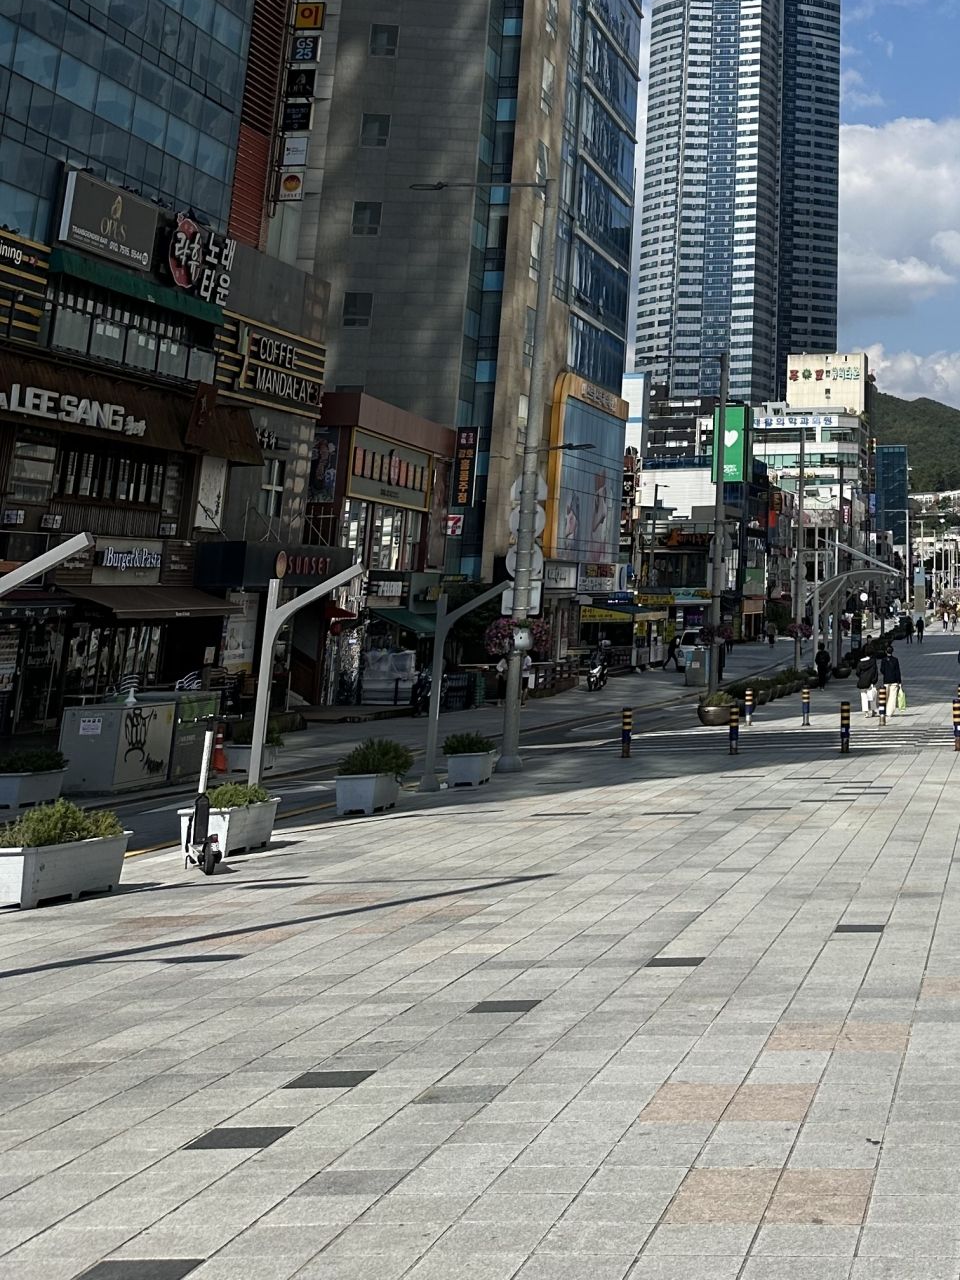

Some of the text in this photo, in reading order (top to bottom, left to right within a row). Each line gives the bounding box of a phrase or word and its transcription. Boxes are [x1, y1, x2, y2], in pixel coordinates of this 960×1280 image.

[295, 48, 312, 60] 25
[297, 38, 314, 49] GS
[205, 232, 237, 272] 노래
[200, 268, 231, 307] 타운
[259, 336, 299, 370] COFFEE
[256, 367, 314, 404] MANDALAY
